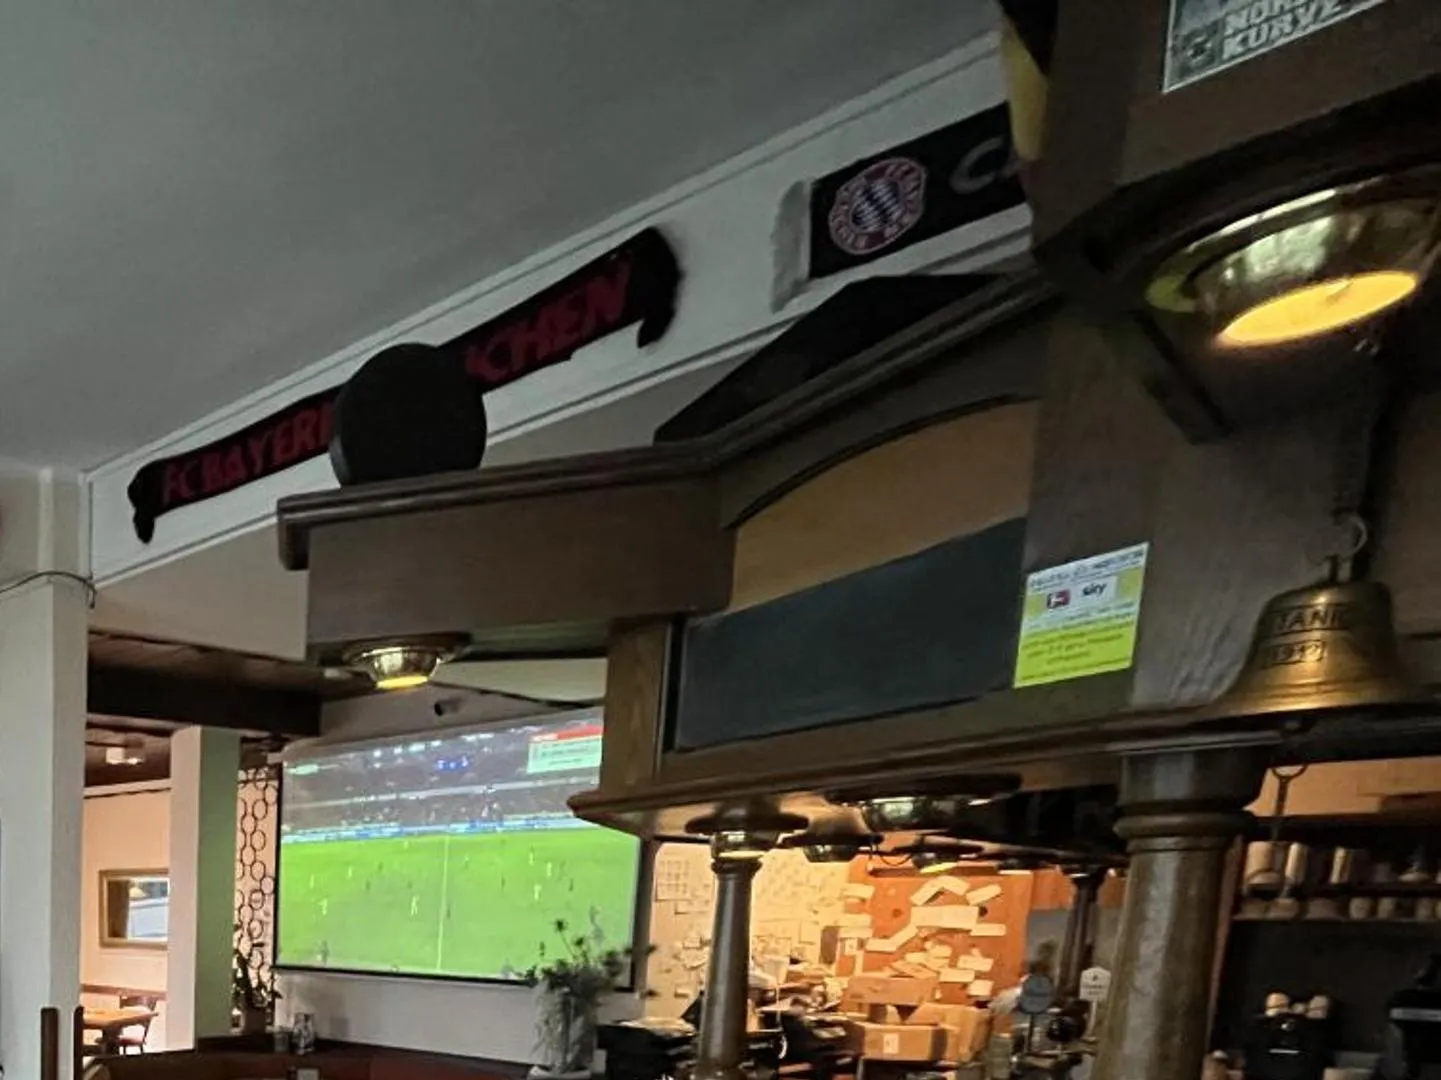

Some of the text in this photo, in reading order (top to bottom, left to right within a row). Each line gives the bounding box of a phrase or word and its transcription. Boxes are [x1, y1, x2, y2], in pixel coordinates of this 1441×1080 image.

[1224, 0, 1308, 36] NOR
[161, 462, 191, 505] FC
[466, 262, 630, 382] CHEN
